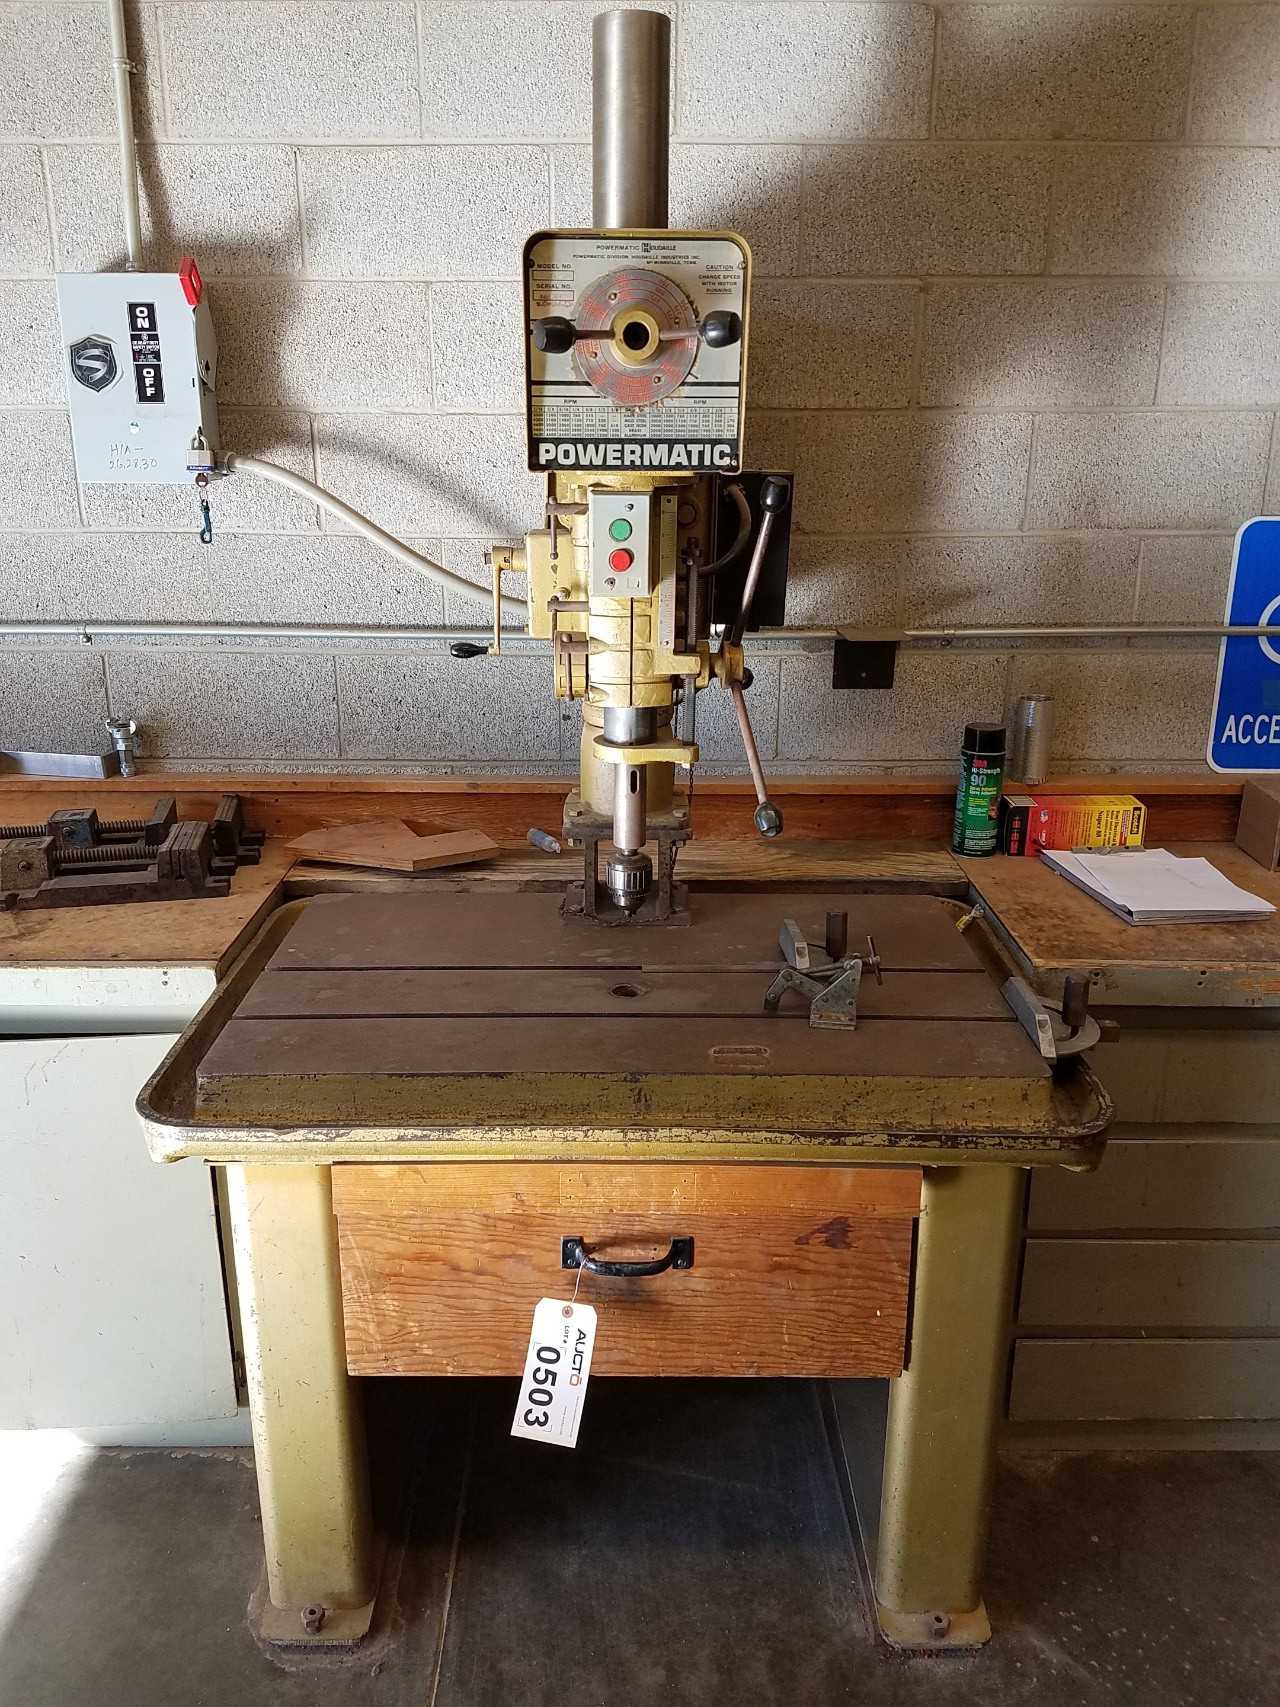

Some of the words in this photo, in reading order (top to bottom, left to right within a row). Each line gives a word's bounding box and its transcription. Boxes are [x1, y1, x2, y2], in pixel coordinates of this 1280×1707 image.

[135, 306, 150, 329] ON
[142, 368, 156, 397] OFF
[538, 442, 731, 466] POWERMATIC
[970, 775, 987, 786] 90
[523, 1346, 561, 1428] 0503
